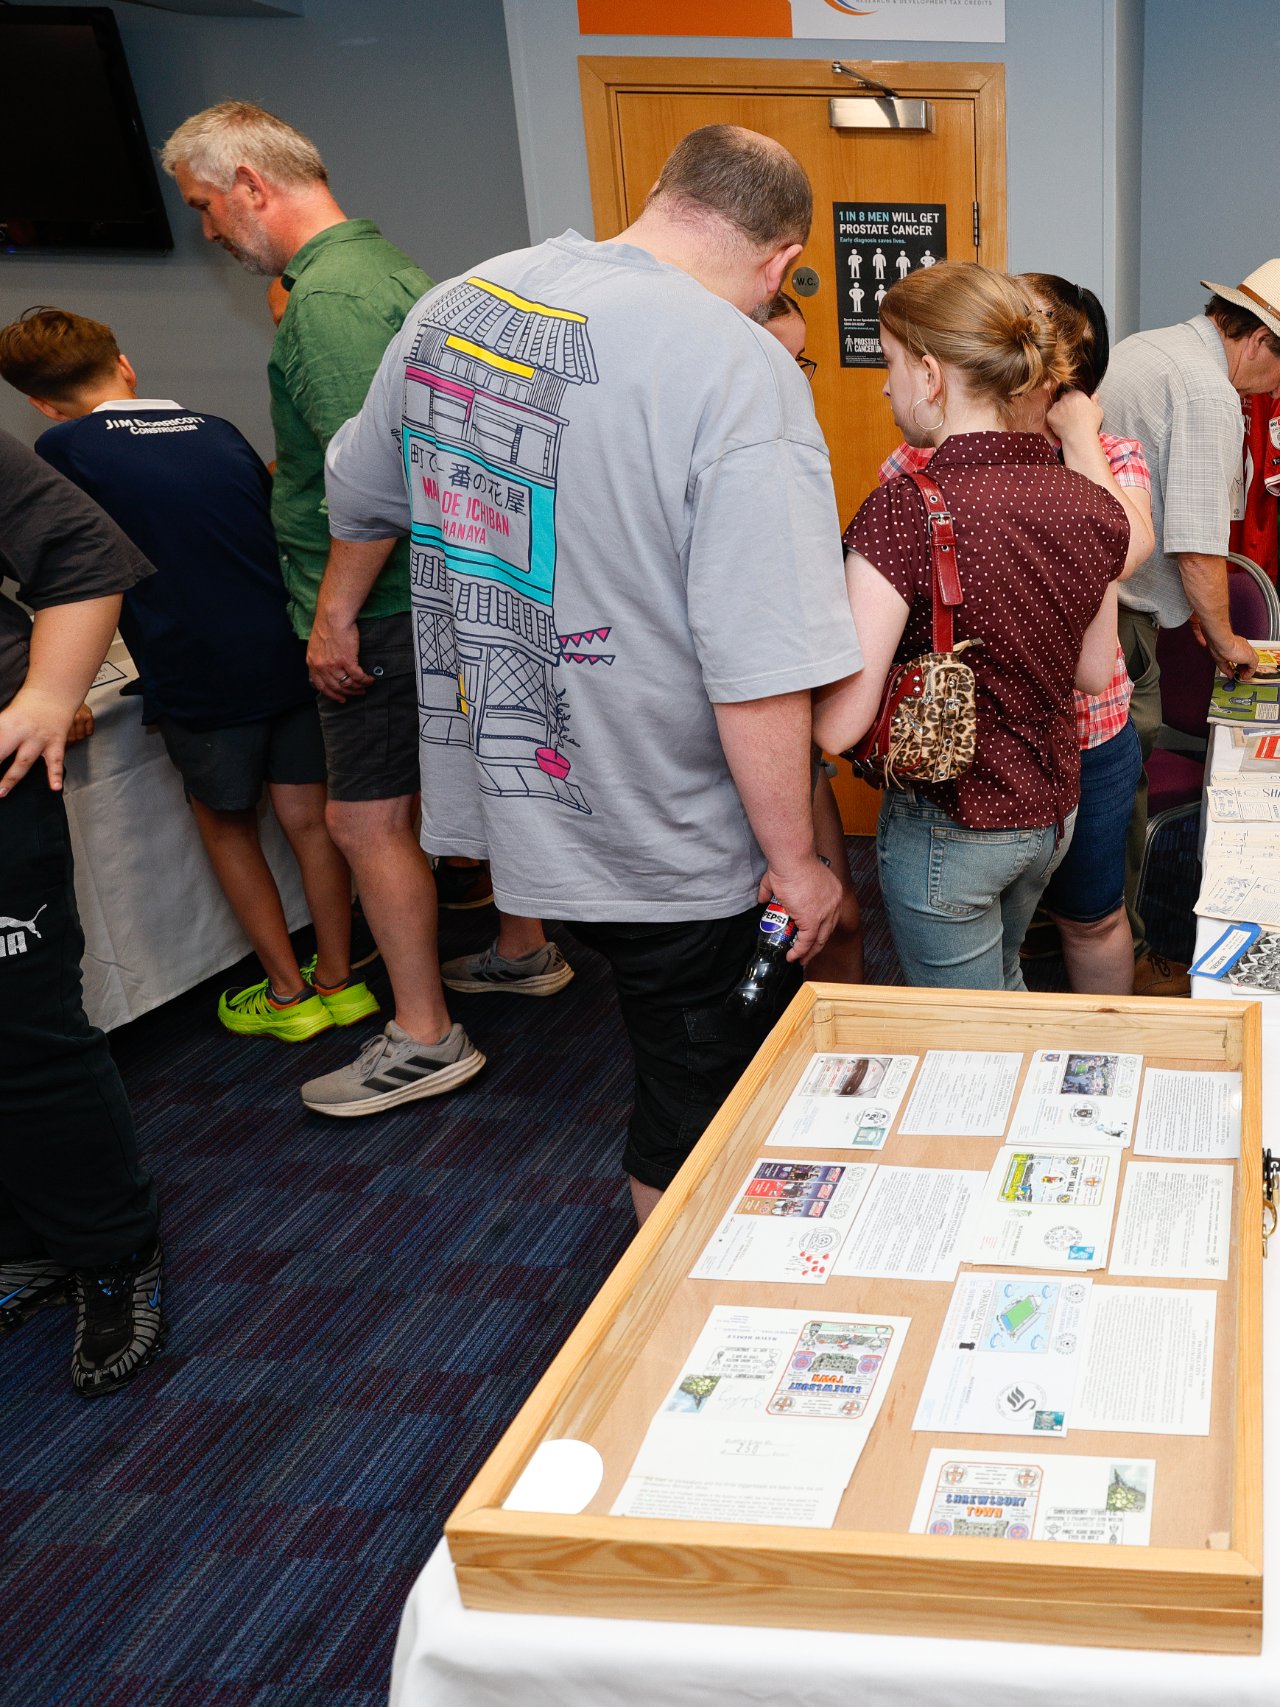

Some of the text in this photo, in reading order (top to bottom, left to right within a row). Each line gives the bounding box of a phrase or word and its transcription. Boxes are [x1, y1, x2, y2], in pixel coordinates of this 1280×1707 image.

[839, 211, 940, 223] 1 IN 8 MEN WILL GET
[840, 224, 933, 236] PROSTATE CANCER
[854, 338, 880, 346] PROSTATE
[854, 345, 874, 353] CANCER
[105, 419, 133, 430] JIM
[130, 424, 199, 436] CONSTRUCTION
[441, 490, 510, 537] DE ICHIBAN
[443, 519, 487, 545] HANAYA
[763, 910, 787, 925] PEPSI
[1066, 1166, 1078, 1192] PORT VALE
[969, 1289, 991, 1340] SWANSEA CITY
[809, 1373, 846, 1383] TOWN
[787, 1382, 863, 1393] SHREWSBURY
[944, 1493, 1027, 1507] SHREWSBURY
[964, 1506, 1003, 1518] TOWN
